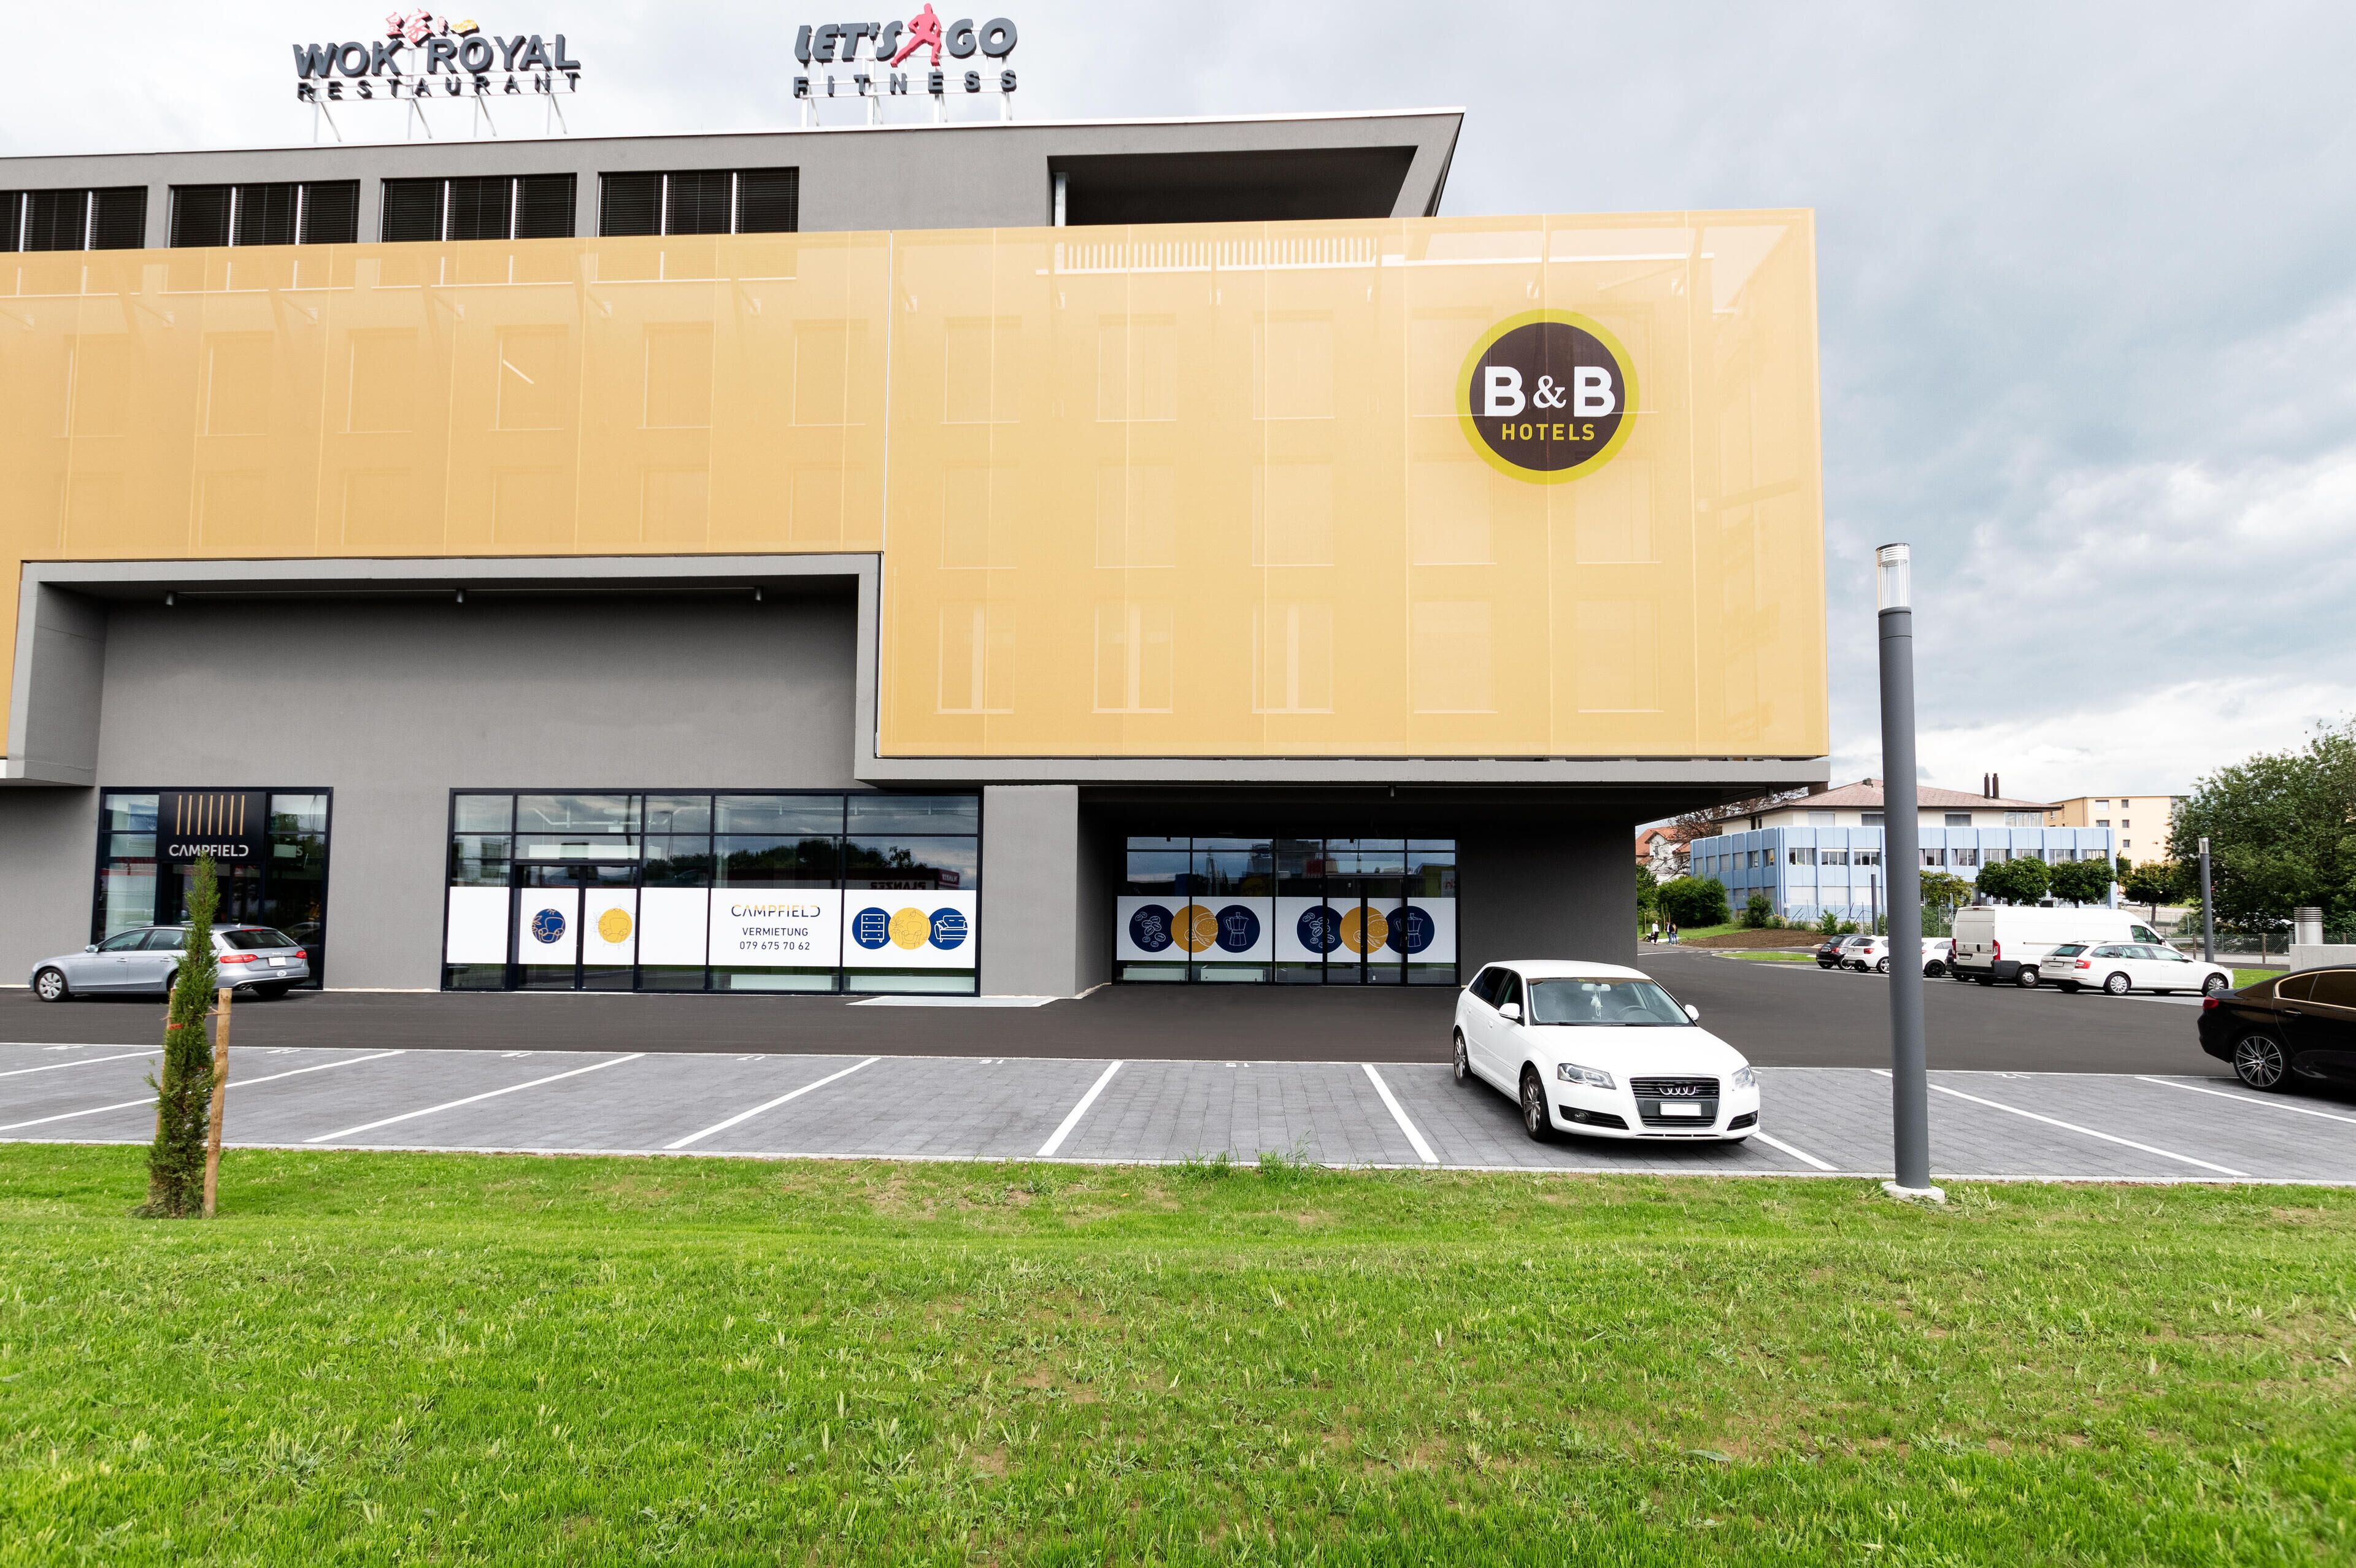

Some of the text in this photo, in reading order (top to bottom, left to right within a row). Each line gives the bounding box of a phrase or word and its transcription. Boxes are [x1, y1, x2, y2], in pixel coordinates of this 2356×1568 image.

[795, 18, 1017, 64] LET'S GO
[293, 34, 582, 79] WOK ROYAL
[297, 72, 582, 102] RESTAURANT
[794, 70, 1017, 98] FITNESS
[1484, 366, 1615, 417] B&B
[1501, 423, 1595, 441] HOTELS
[169, 844, 249, 857] CAMPFIELD
[731, 904, 821, 918] CAMPFIELD
[742, 927, 809, 937] VERMIETUNG
[739, 941, 810, 951] 079 675 70 62
